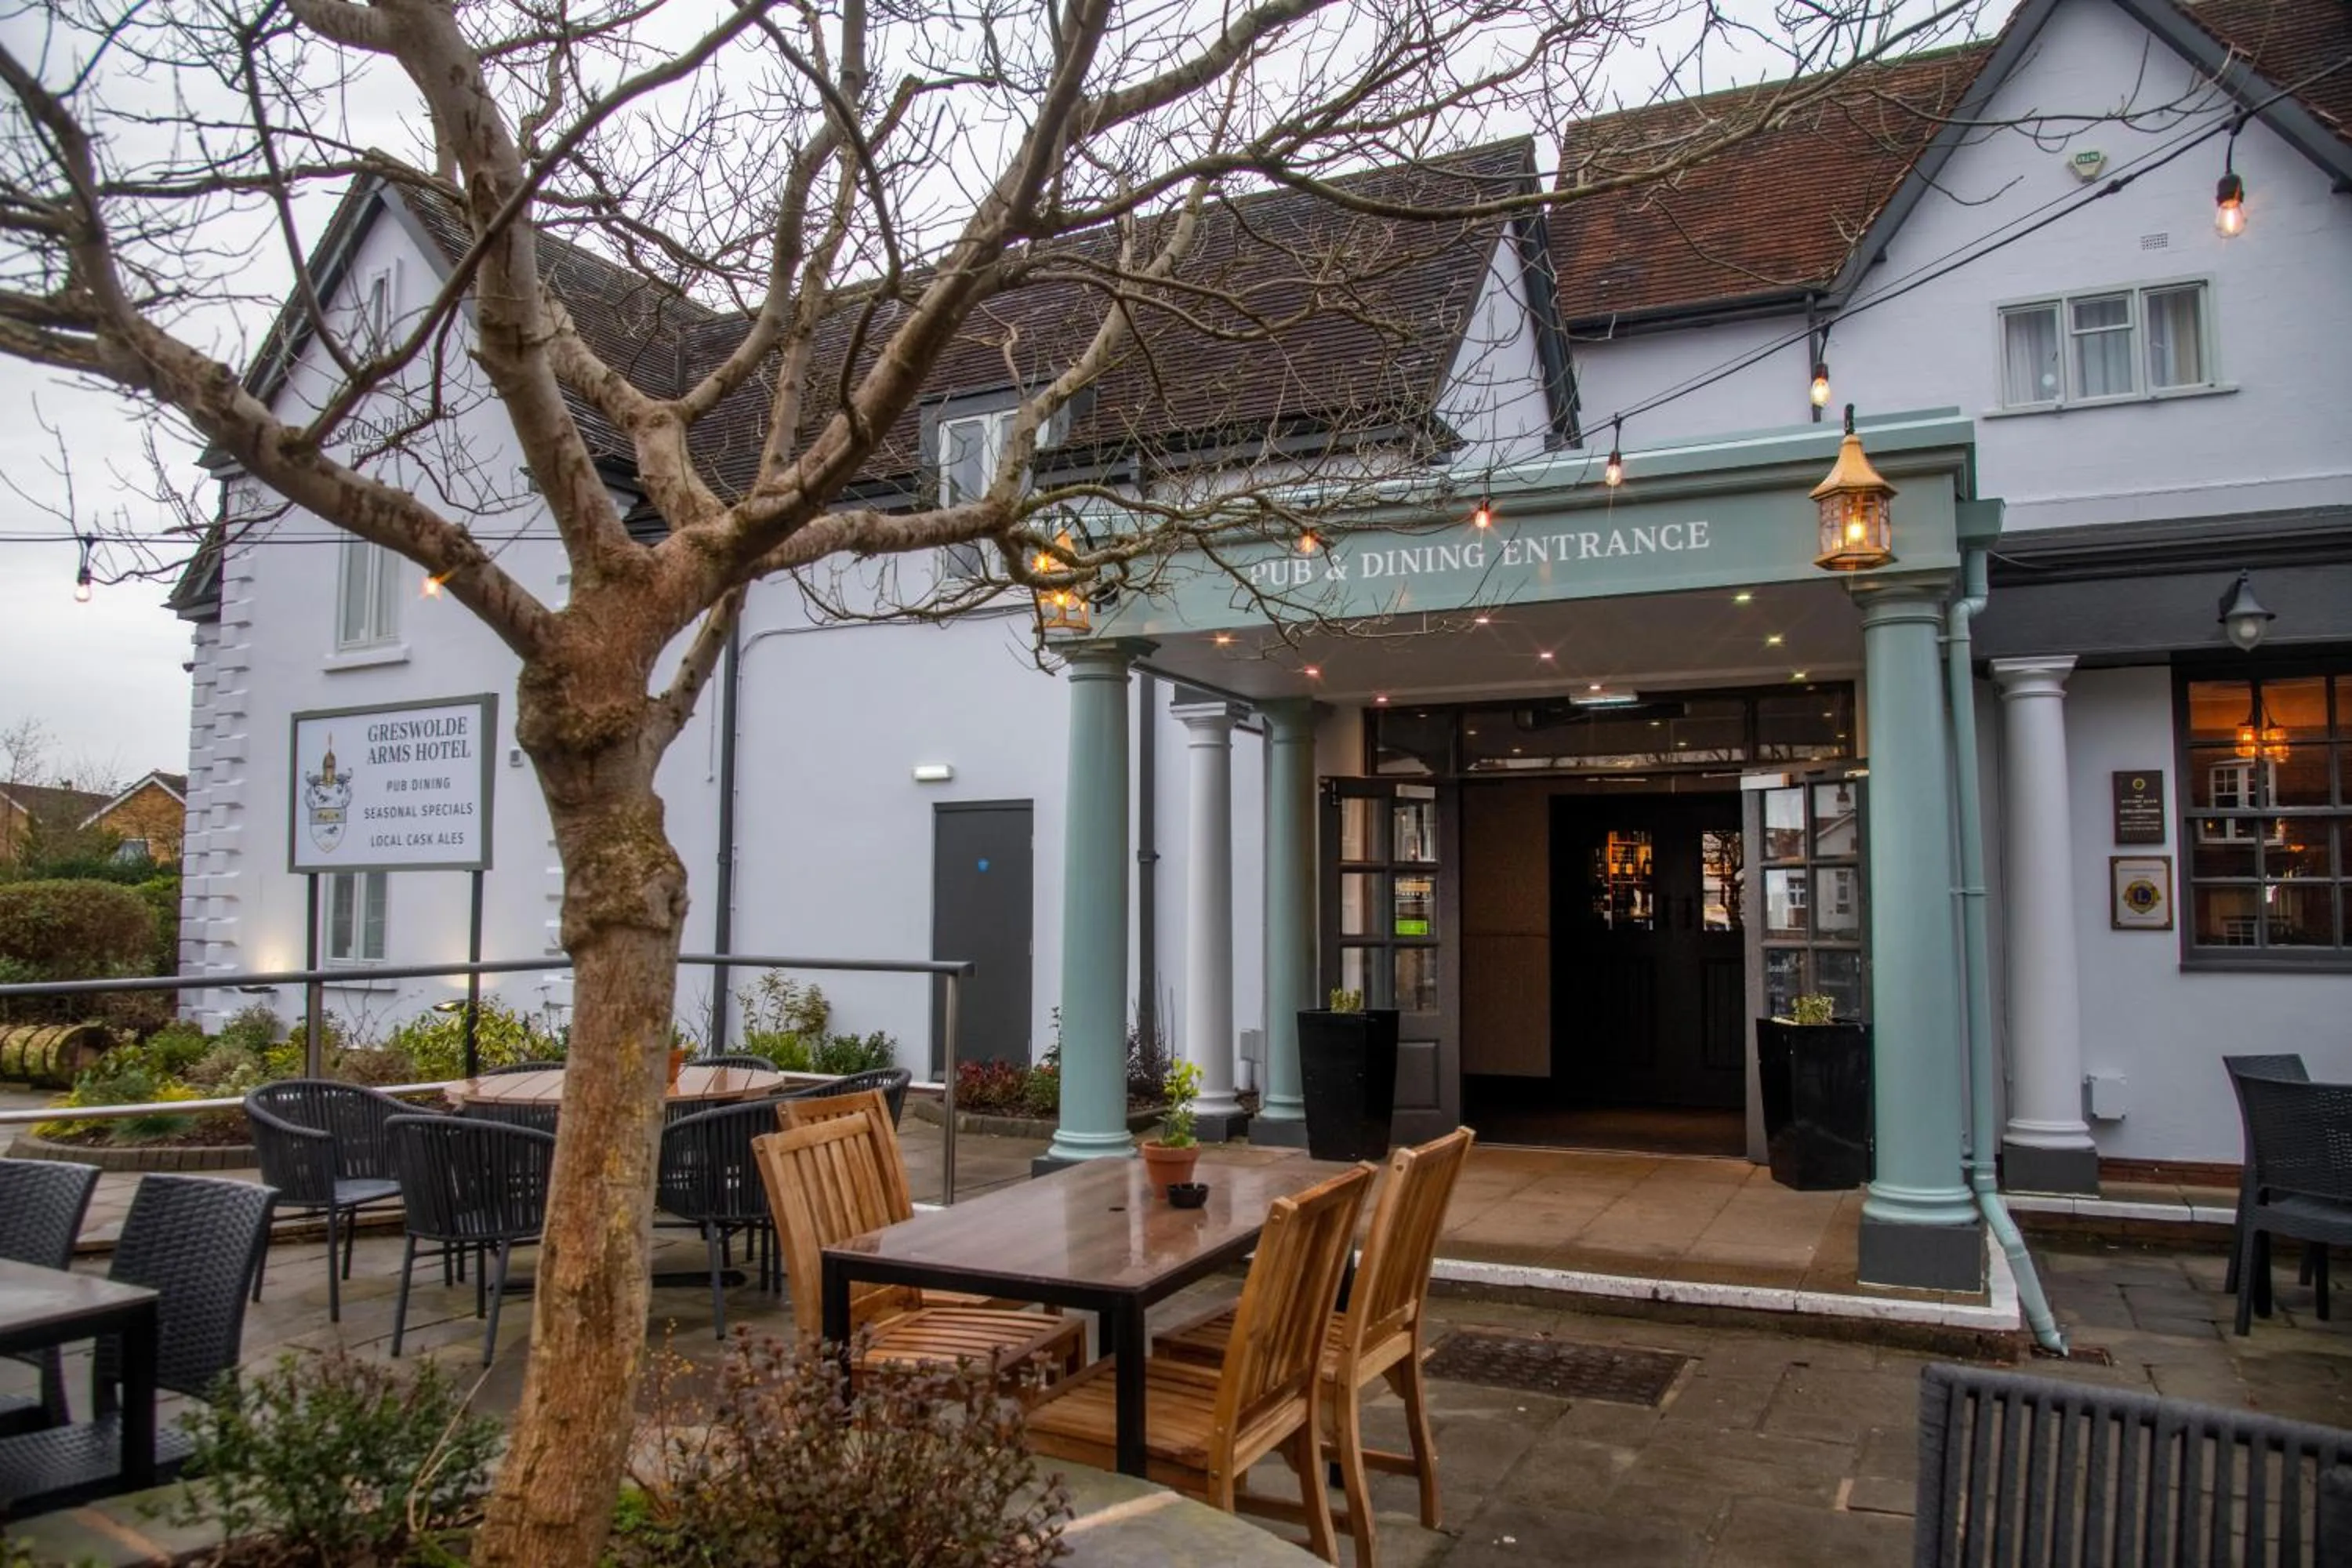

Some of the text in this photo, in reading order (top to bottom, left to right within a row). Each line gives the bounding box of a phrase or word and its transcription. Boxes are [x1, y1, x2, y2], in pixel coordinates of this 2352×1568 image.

[1250, 521, 1710, 586] PUB & DINING ENTRANCE
[368, 717, 467, 742] GRESWOLDE
[366, 739, 471, 765] ARMS HOTEL
[387, 777, 451, 792] PUB DINING
[364, 802, 474, 819] SEASONAL SPECIALS
[371, 832, 464, 848] LOCAL CASK ALES
